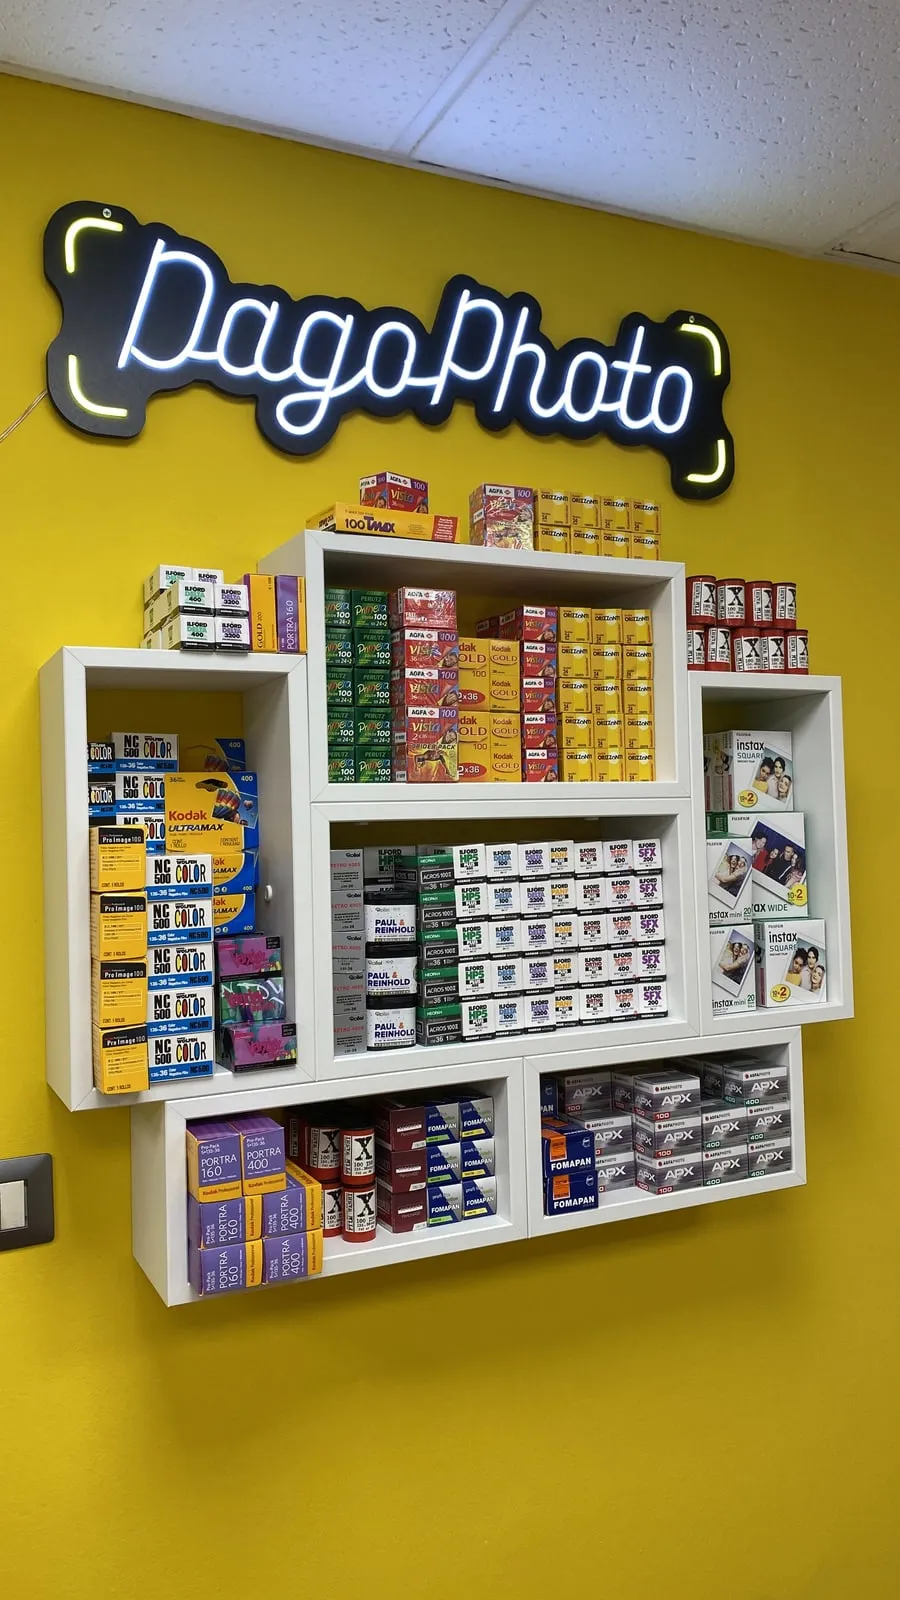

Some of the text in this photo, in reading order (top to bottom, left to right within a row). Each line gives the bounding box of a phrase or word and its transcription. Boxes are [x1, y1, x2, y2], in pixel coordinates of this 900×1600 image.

[117, 237, 694, 436] DagoPhoto
[413, 481, 425, 491] 100
[727, 587, 744, 606] X
[440, 633, 456, 641] 100
[744, 638, 760, 657] X
[770, 638, 784, 656] X
[492, 654, 518, 662] GOLD
[124, 735, 139, 747] NC
[737, 739, 764, 750] instax
[90, 746, 112, 760] COLOR
[124, 748, 139, 758] 500
[144, 742, 171, 758] COLOR
[123, 776, 138, 788] NC
[124, 789, 138, 798] 500
[169, 810, 207, 820] Kodak
[168, 824, 224, 832] ULTRAMAX
[460, 854, 478, 863] HP5
[639, 848, 656, 857] SFX
[154, 859, 171, 873] NC
[155, 874, 171, 884] 500
[176, 864, 206, 883] COLOR
[640, 884, 657, 892] SFX
[462, 892, 480, 901] HP5
[153, 904, 170, 918] NC
[768, 904, 788, 912] WIDE
[175, 908, 205, 928] COLOR
[709, 911, 728, 919] nstax
[153, 918, 170, 929] 500
[768, 932, 798, 943] instax
[154, 949, 170, 963] NC
[154, 963, 170, 974] 500
[176, 953, 206, 972] COLOR
[466, 971, 484, 980] HP5
[368, 979, 410, 987] REINHOLD
[154, 994, 170, 1008] NC
[644, 991, 661, 1000] SFX
[175, 998, 206, 1017] COLOR
[712, 1000, 733, 1008] instax
[154, 1009, 170, 1019] 500
[469, 1010, 487, 1019] HP5
[375, 1023, 396, 1031] PAUL
[375, 1029, 415, 1038] REINHOLD
[751, 1080, 779, 1092] APX
[573, 1086, 602, 1099] APX
[661, 1093, 691, 1106] APX
[464, 1117, 492, 1126] FOMAPAN
[756, 1114, 783, 1127] APX
[428, 1123, 457, 1132] FOMAPAN
[712, 1121, 740, 1135] APX
[664, 1130, 693, 1143] APX
[247, 1147, 281, 1160] PORTRA
[354, 1136, 372, 1160] X
[201, 1154, 237, 1168] PORTRA
[465, 1157, 492, 1167] FOMAPAN
[551, 1158, 591, 1170] FOMAPAN
[202, 1166, 222, 1178] 160
[430, 1163, 459, 1172] FOMAPAN
[664, 1167, 694, 1180] APX
[466, 1196, 494, 1206] FOMAPAN
[280, 1195, 288, 1231] PORTRA
[431, 1204, 460, 1214] FOMAPAN
[219, 1204, 227, 1242] PORTRA
[290, 1208, 298, 1229] 400
[228, 1220, 238, 1240] 160
[282, 1240, 290, 1276] PORTRA
[291, 1253, 300, 1274] 400
[220, 1251, 228, 1288] PORTRA
[228, 1266, 238, 1287] 160
